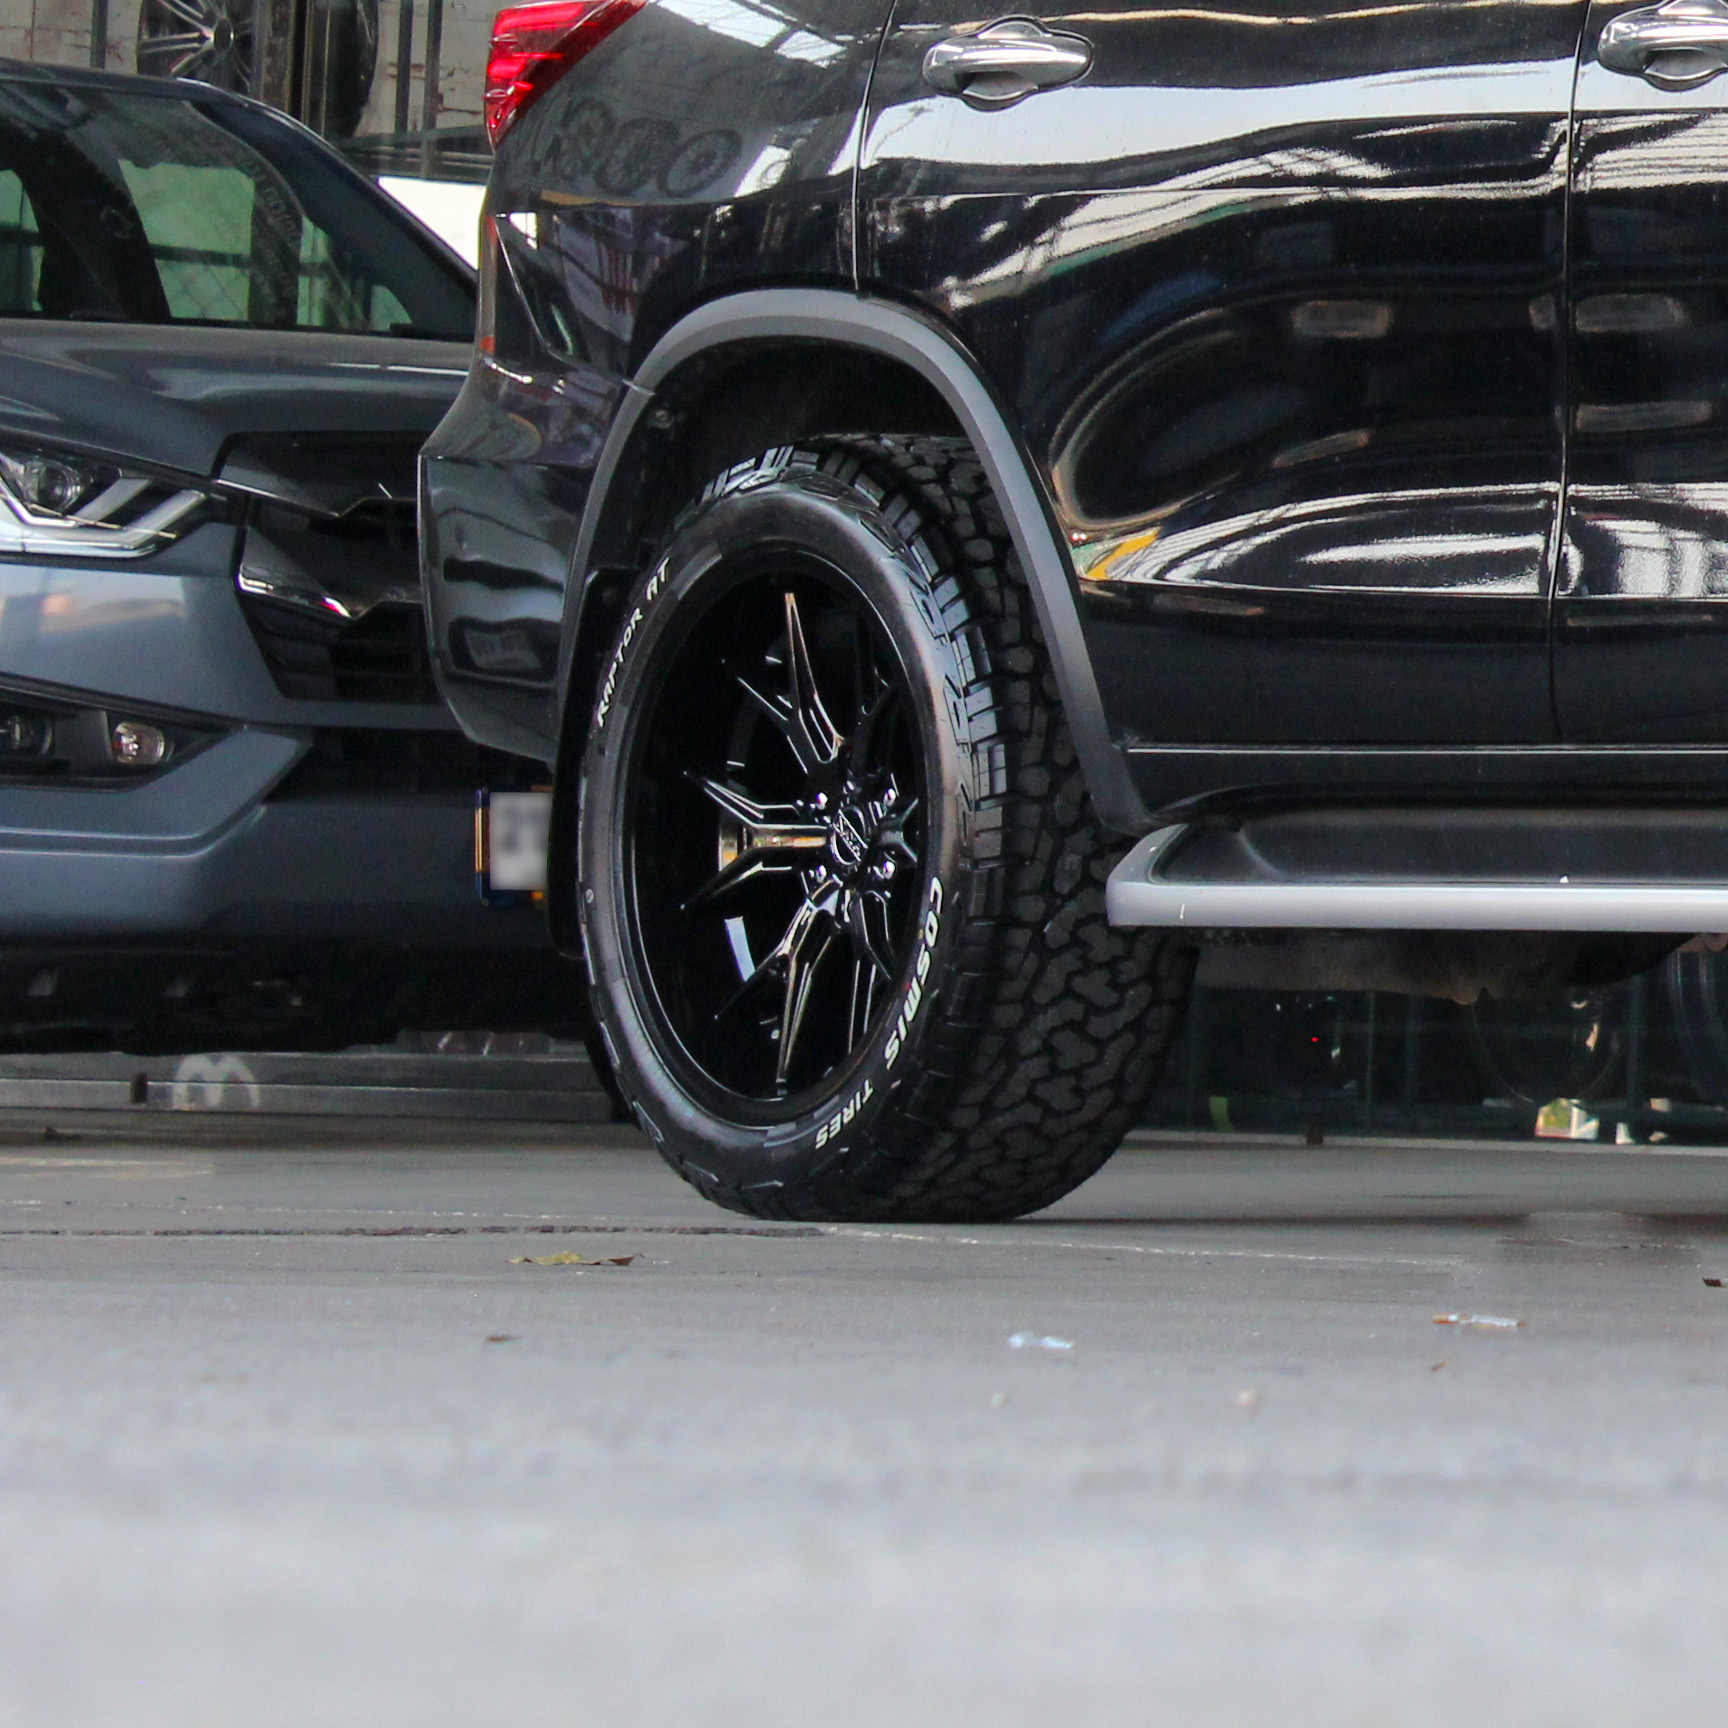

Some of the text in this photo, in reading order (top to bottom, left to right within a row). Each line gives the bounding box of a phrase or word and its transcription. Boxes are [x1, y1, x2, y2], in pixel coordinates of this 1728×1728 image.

[597, 557, 669, 727] RAPTOR AT
[815, 876, 943, 1150] COSMIS TIRES
